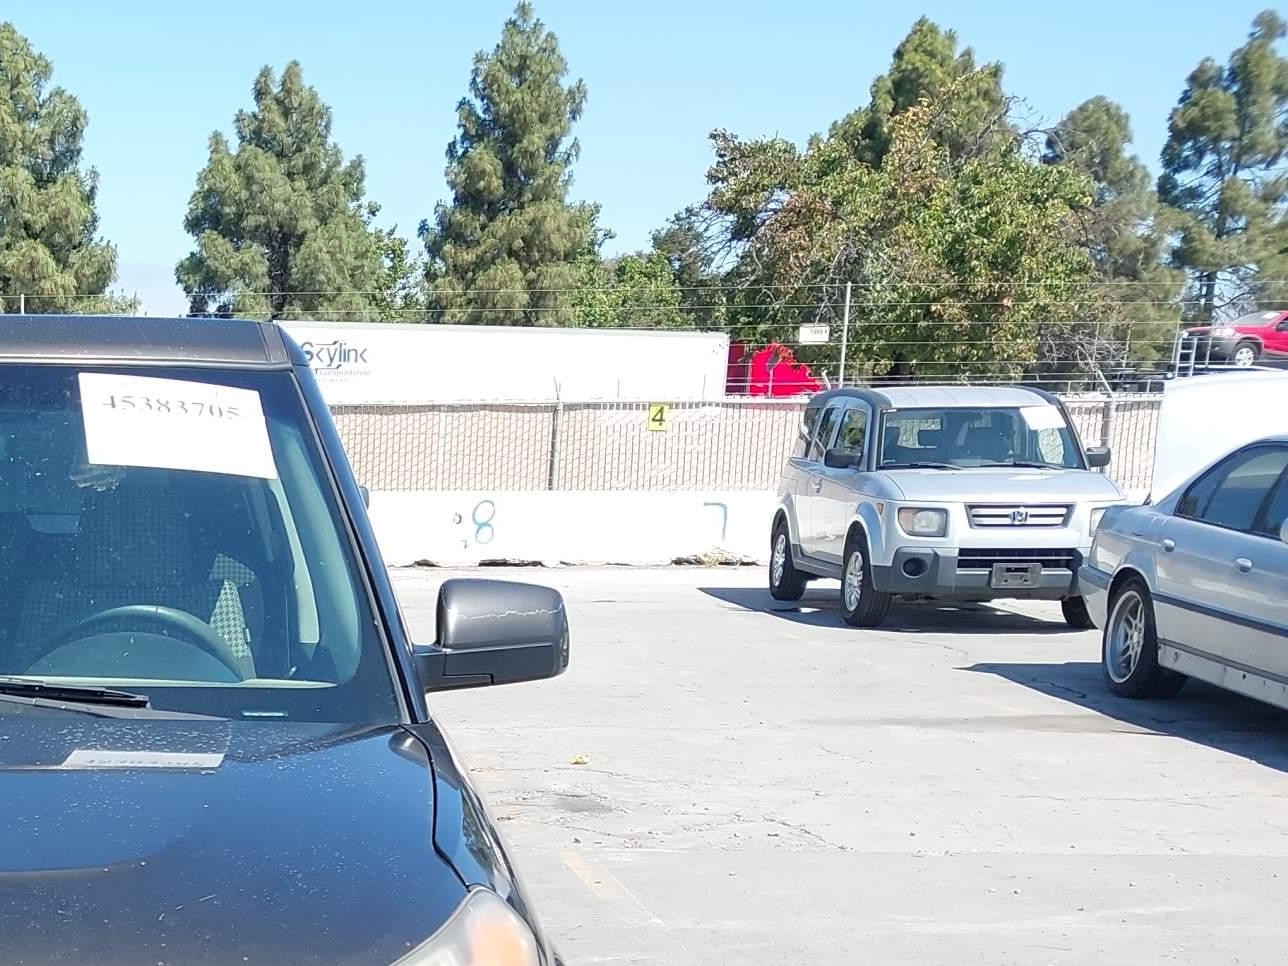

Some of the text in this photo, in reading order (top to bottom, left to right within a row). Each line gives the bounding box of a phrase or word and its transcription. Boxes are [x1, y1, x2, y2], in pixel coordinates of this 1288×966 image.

[300, 341, 368, 368] Skylink
[103, 395, 241, 420] 45383705
[651, 405, 667, 426] 4
[472, 499, 496, 545] 8
